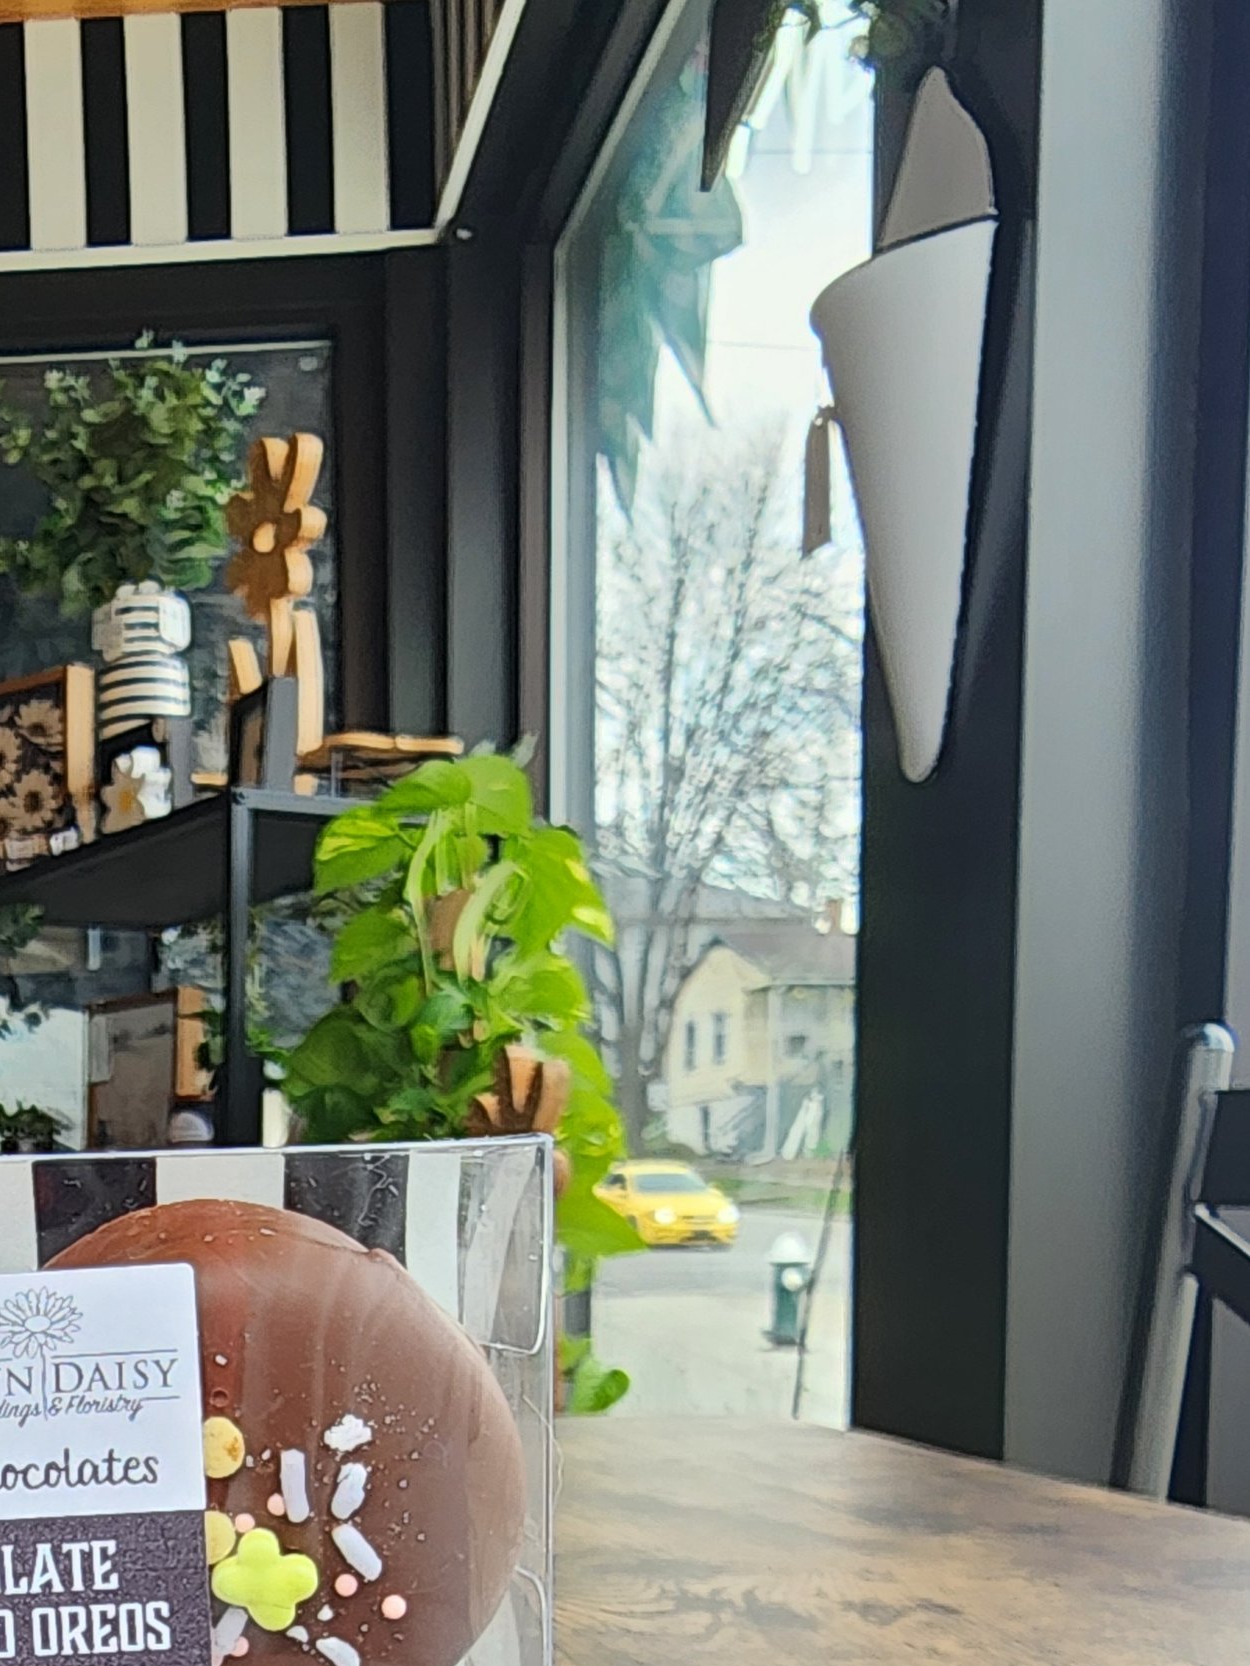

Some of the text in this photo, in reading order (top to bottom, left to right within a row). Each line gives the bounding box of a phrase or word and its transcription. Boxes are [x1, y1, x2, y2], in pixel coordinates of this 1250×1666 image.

[53, 1358, 178, 1394] DAISY
[48, 1398, 65, 1417] &
[65, 1394, 144, 1421] Floristry
[32, 1601, 171, 1658] OREOS
